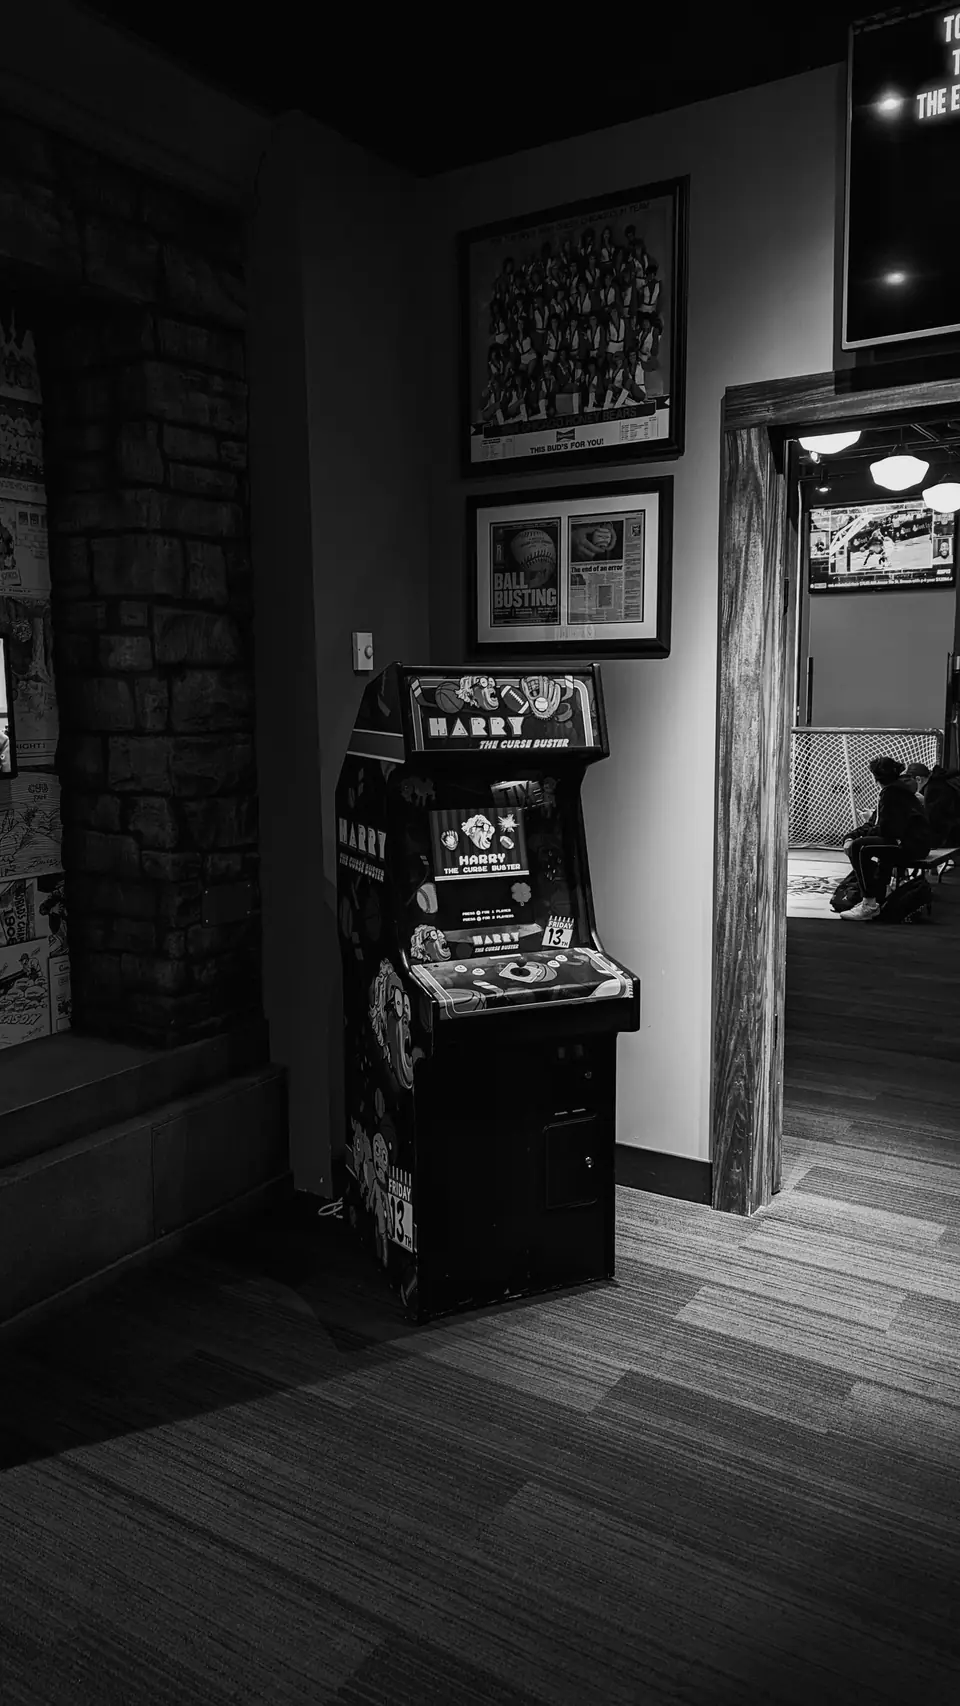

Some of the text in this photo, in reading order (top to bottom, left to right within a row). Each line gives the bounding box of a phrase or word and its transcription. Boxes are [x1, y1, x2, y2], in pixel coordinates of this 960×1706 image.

[916, 87, 947, 120] THE
[565, 411, 600, 426] HONEY
[602, 406, 637, 421] BEARS
[530, 438, 604, 454] THIS BUD'S FOR YOU!
[581, 565, 593, 573] end
[494, 571, 528, 590] BALL
[494, 587, 557, 608] BUSTING
[428, 716, 525, 738] HARRY
[479, 738, 570, 750] THE CURSE BUSTER
[338, 816, 387, 861] HARRY
[458, 852, 506, 866] HARRY
[443, 863, 521, 875] THE CURSE BUSTER
[548, 920, 574, 930] FRIDAY
[472, 931, 520, 946] HARRY
[484, 945, 501, 953] CURSE
[500, 943, 520, 951] BUSTER
[388, 1177, 412, 1202] FRIDAY
